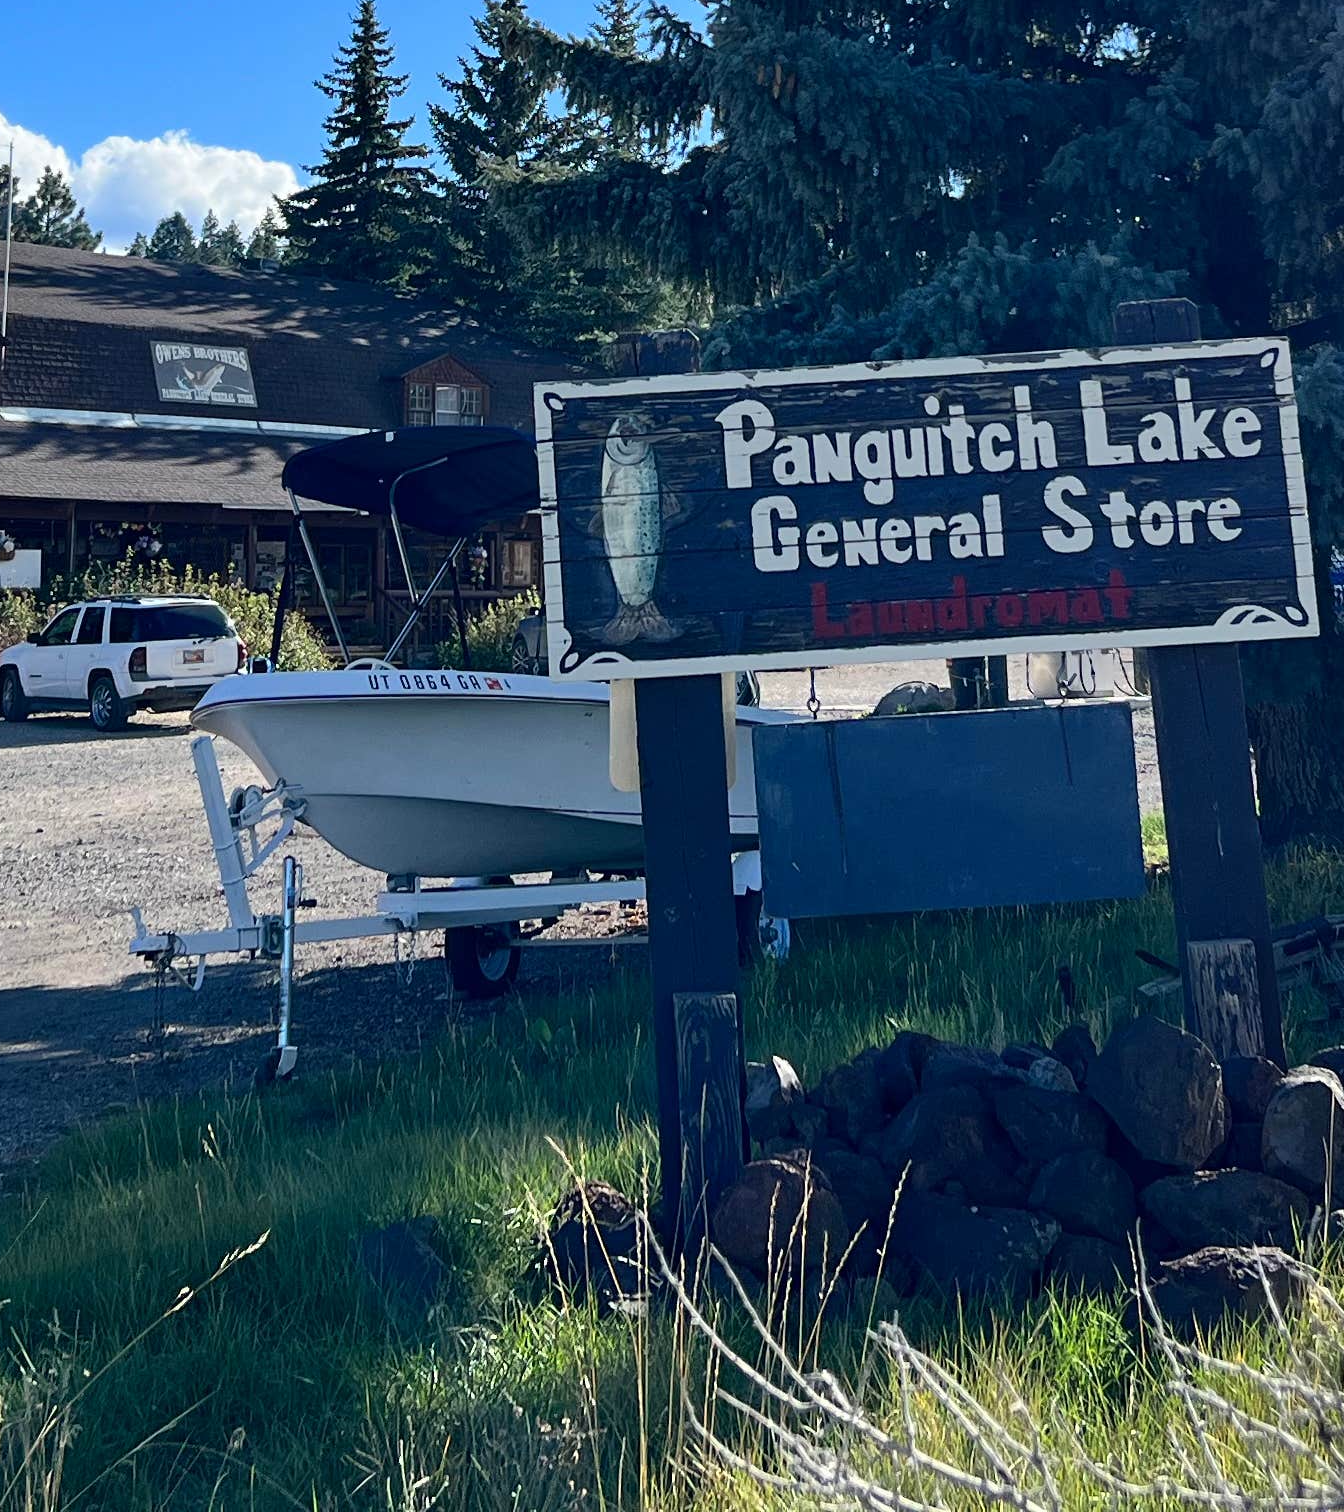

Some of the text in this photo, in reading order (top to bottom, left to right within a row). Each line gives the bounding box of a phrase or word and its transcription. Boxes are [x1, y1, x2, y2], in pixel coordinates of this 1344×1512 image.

[155, 343, 248, 372] OWENS BROTHERS
[715, 378, 1262, 505] Panguitch Lake
[750, 475, 1243, 572] General Store
[810, 568, 1133, 639] Laundromat
[368, 674, 482, 690] UT 0864 GA
